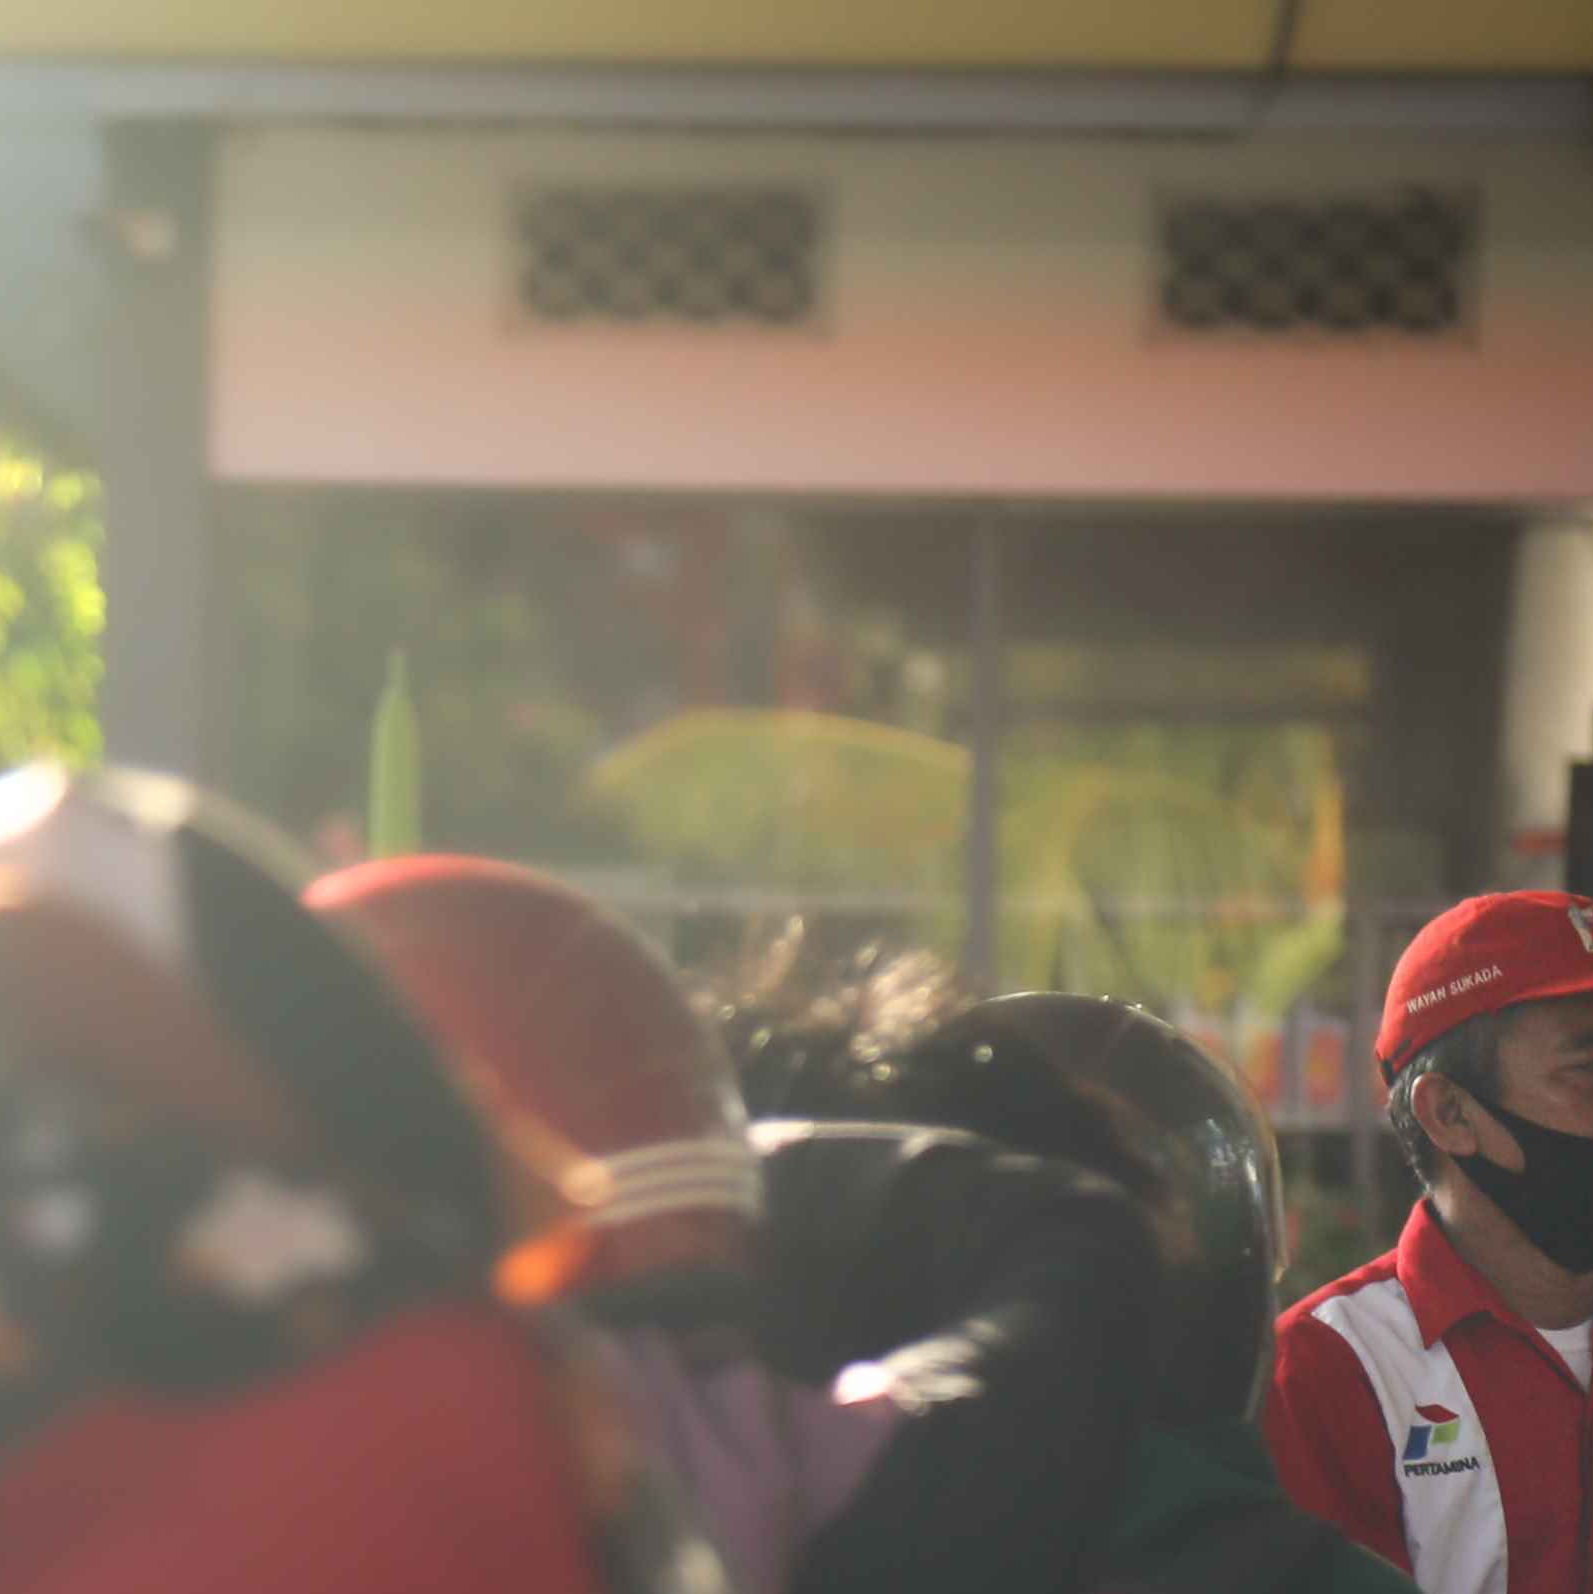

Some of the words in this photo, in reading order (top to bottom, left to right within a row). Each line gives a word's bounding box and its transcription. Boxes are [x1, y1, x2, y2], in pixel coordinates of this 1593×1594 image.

[1406, 986, 1446, 1014] WAYAN
[1449, 964, 1503, 996] SUKADA
[1403, 1456, 1480, 1478] PERTAMINA
